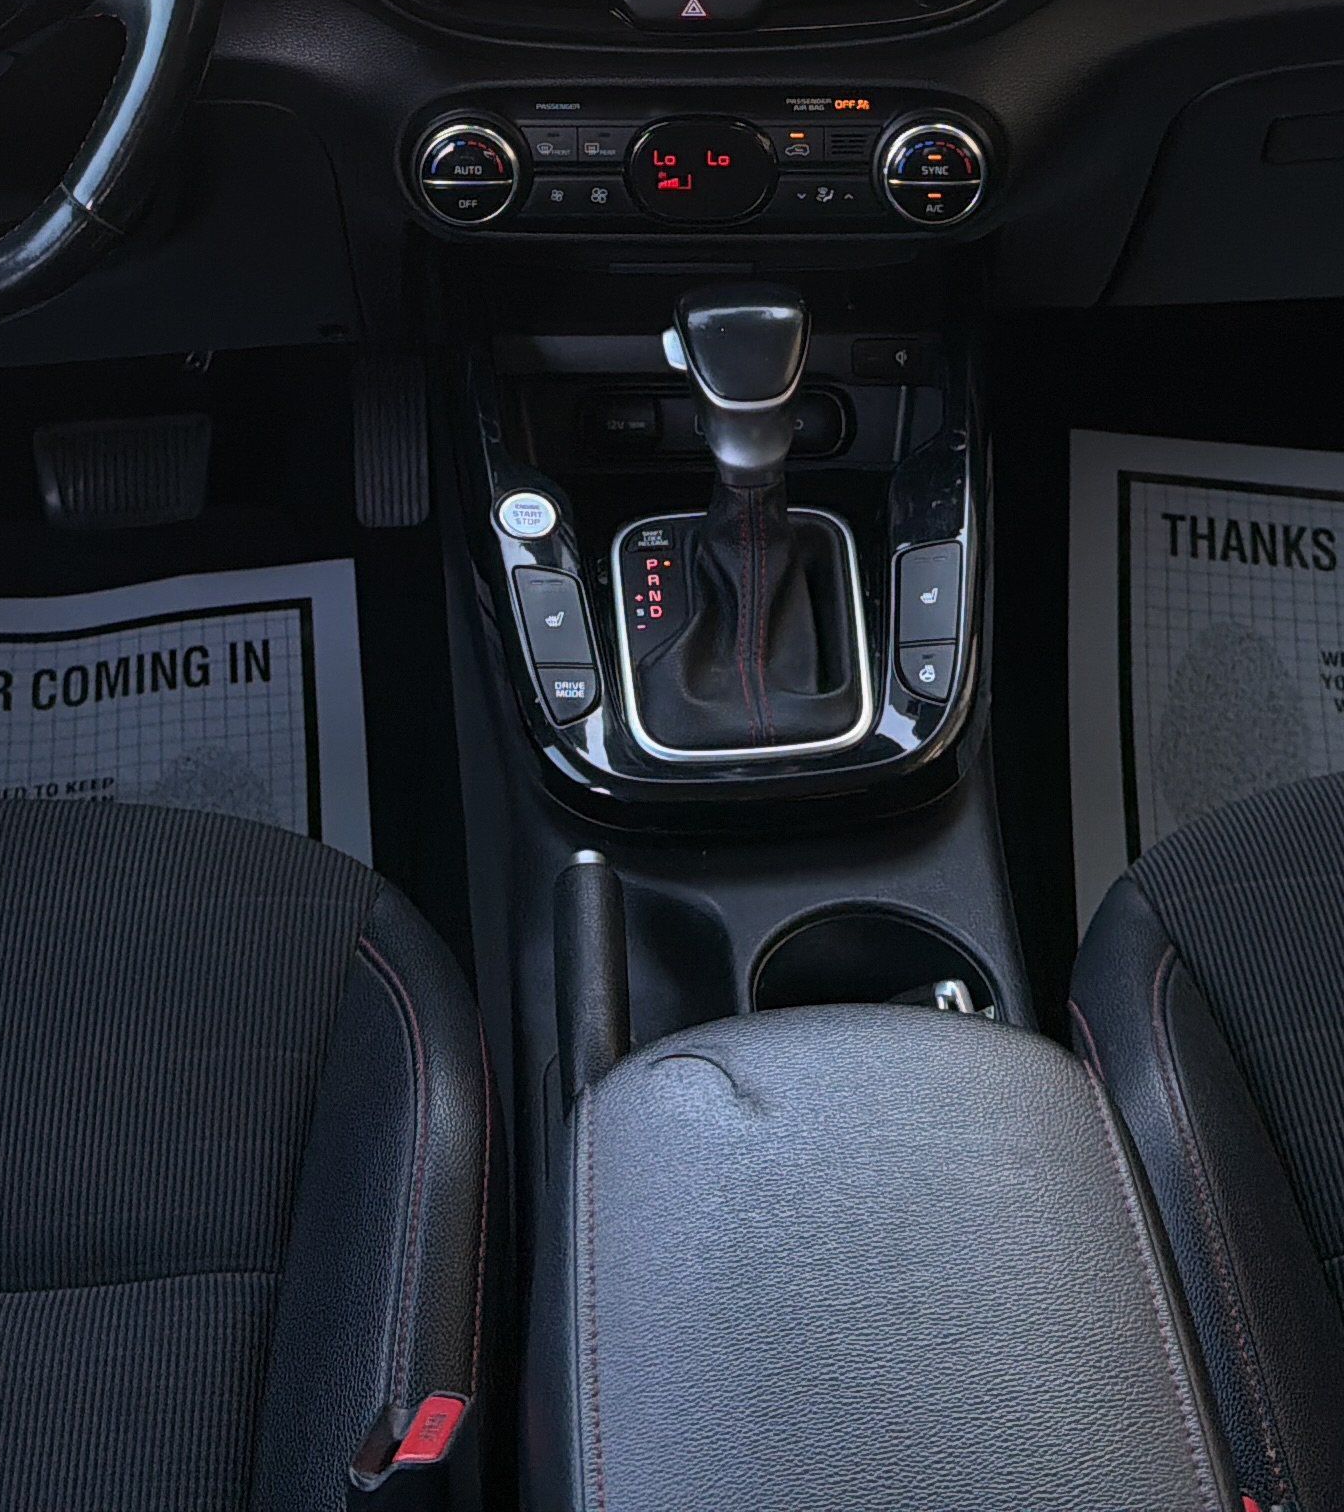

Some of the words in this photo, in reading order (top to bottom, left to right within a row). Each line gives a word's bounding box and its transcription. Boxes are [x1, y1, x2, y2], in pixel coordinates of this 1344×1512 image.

[834, 99, 856, 110] OFF
[653, 150, 677, 167] Lo
[707, 150, 731, 167] Lo
[453, 165, 483, 176] AUTO
[921, 165, 949, 176] SYNC
[458, 199, 478, 209] OFF
[925, 204, 944, 214] A/C
[512, 510, 543, 519] START
[514, 517, 541, 526] STOP
[1162, 513, 1338, 573] THANKS
[646, 559, 659, 570] P
[648, 590, 662, 602] N
[650, 605, 663, 618] D
[31, 645, 212, 711] COMING
[228, 638, 273, 685] IN
[554, 681, 586, 690] DRIVE
[555, 689, 585, 698] MODE
[35, 782, 59, 798] TO
[64, 777, 115, 793] KEEP
